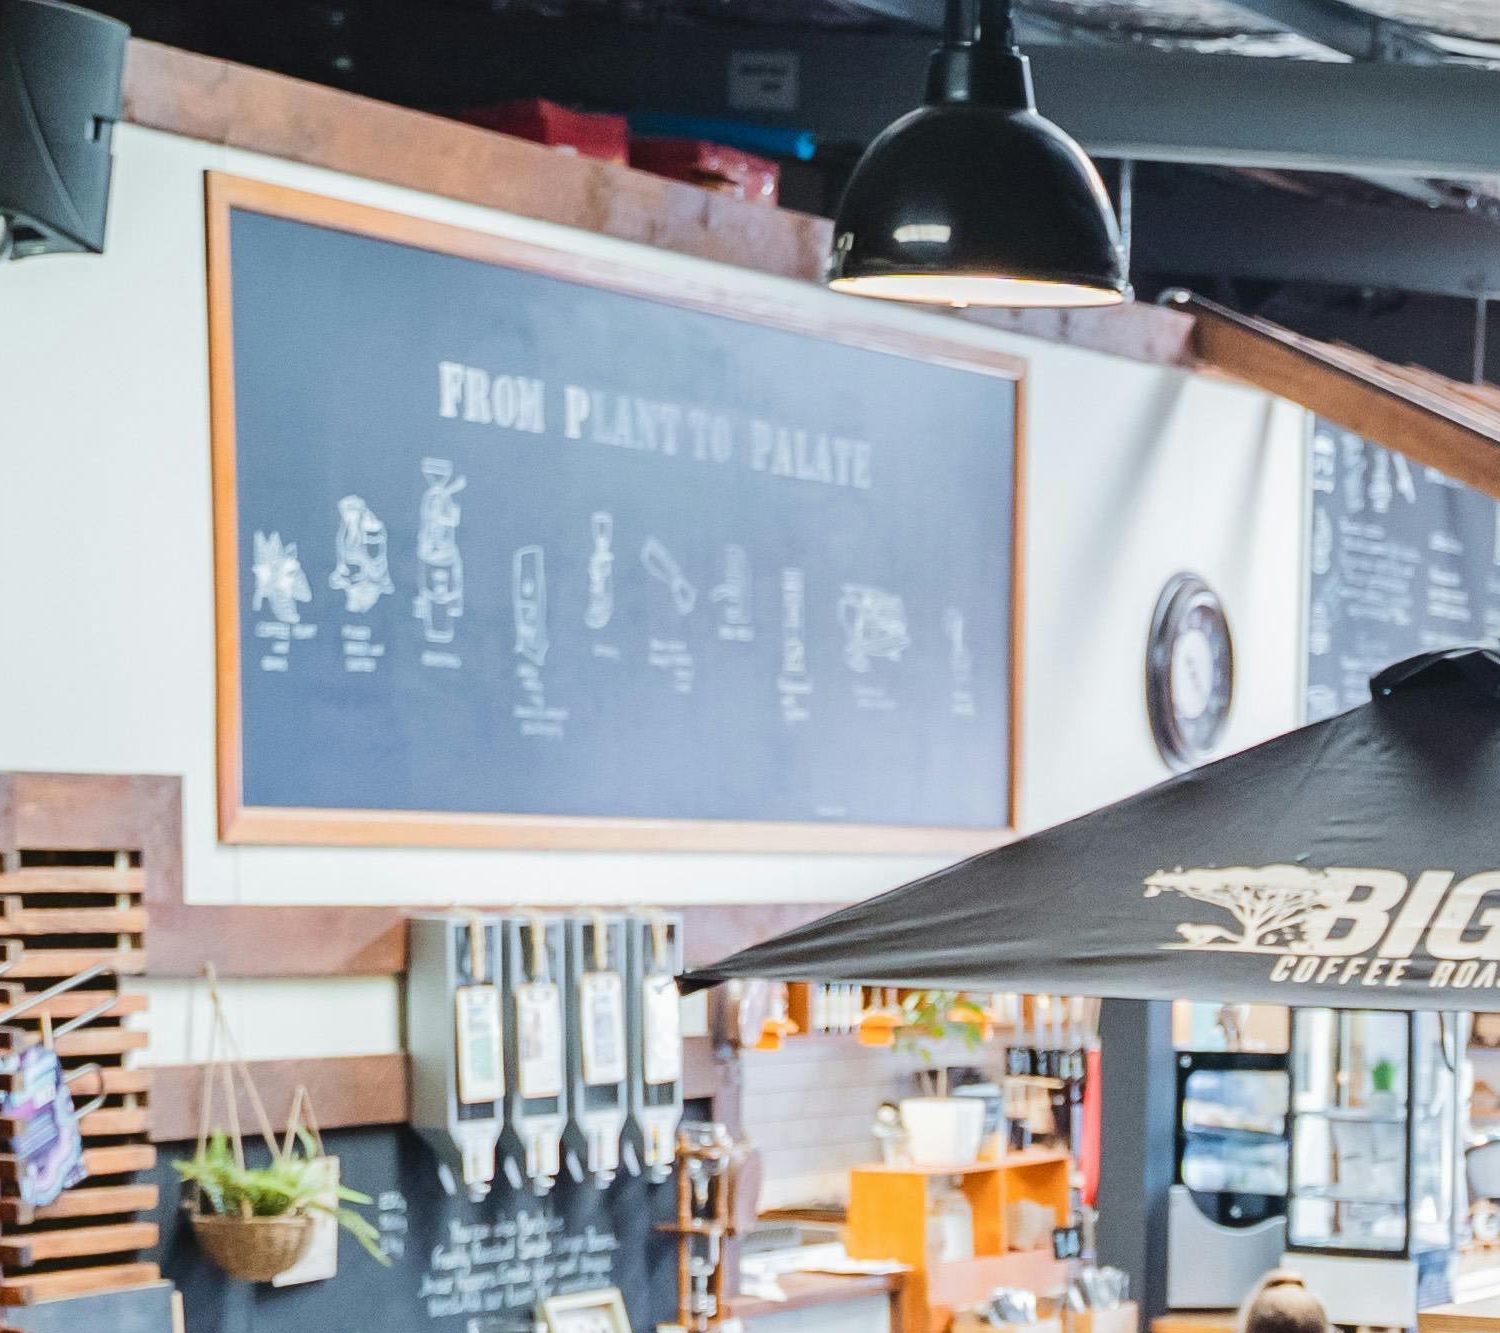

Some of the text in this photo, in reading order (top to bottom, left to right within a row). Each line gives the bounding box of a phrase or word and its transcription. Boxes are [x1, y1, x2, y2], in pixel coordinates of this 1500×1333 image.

[438, 361, 873, 490] FROM PLANT TO PALATE
[1270, 955, 1411, 988] COFFEE
